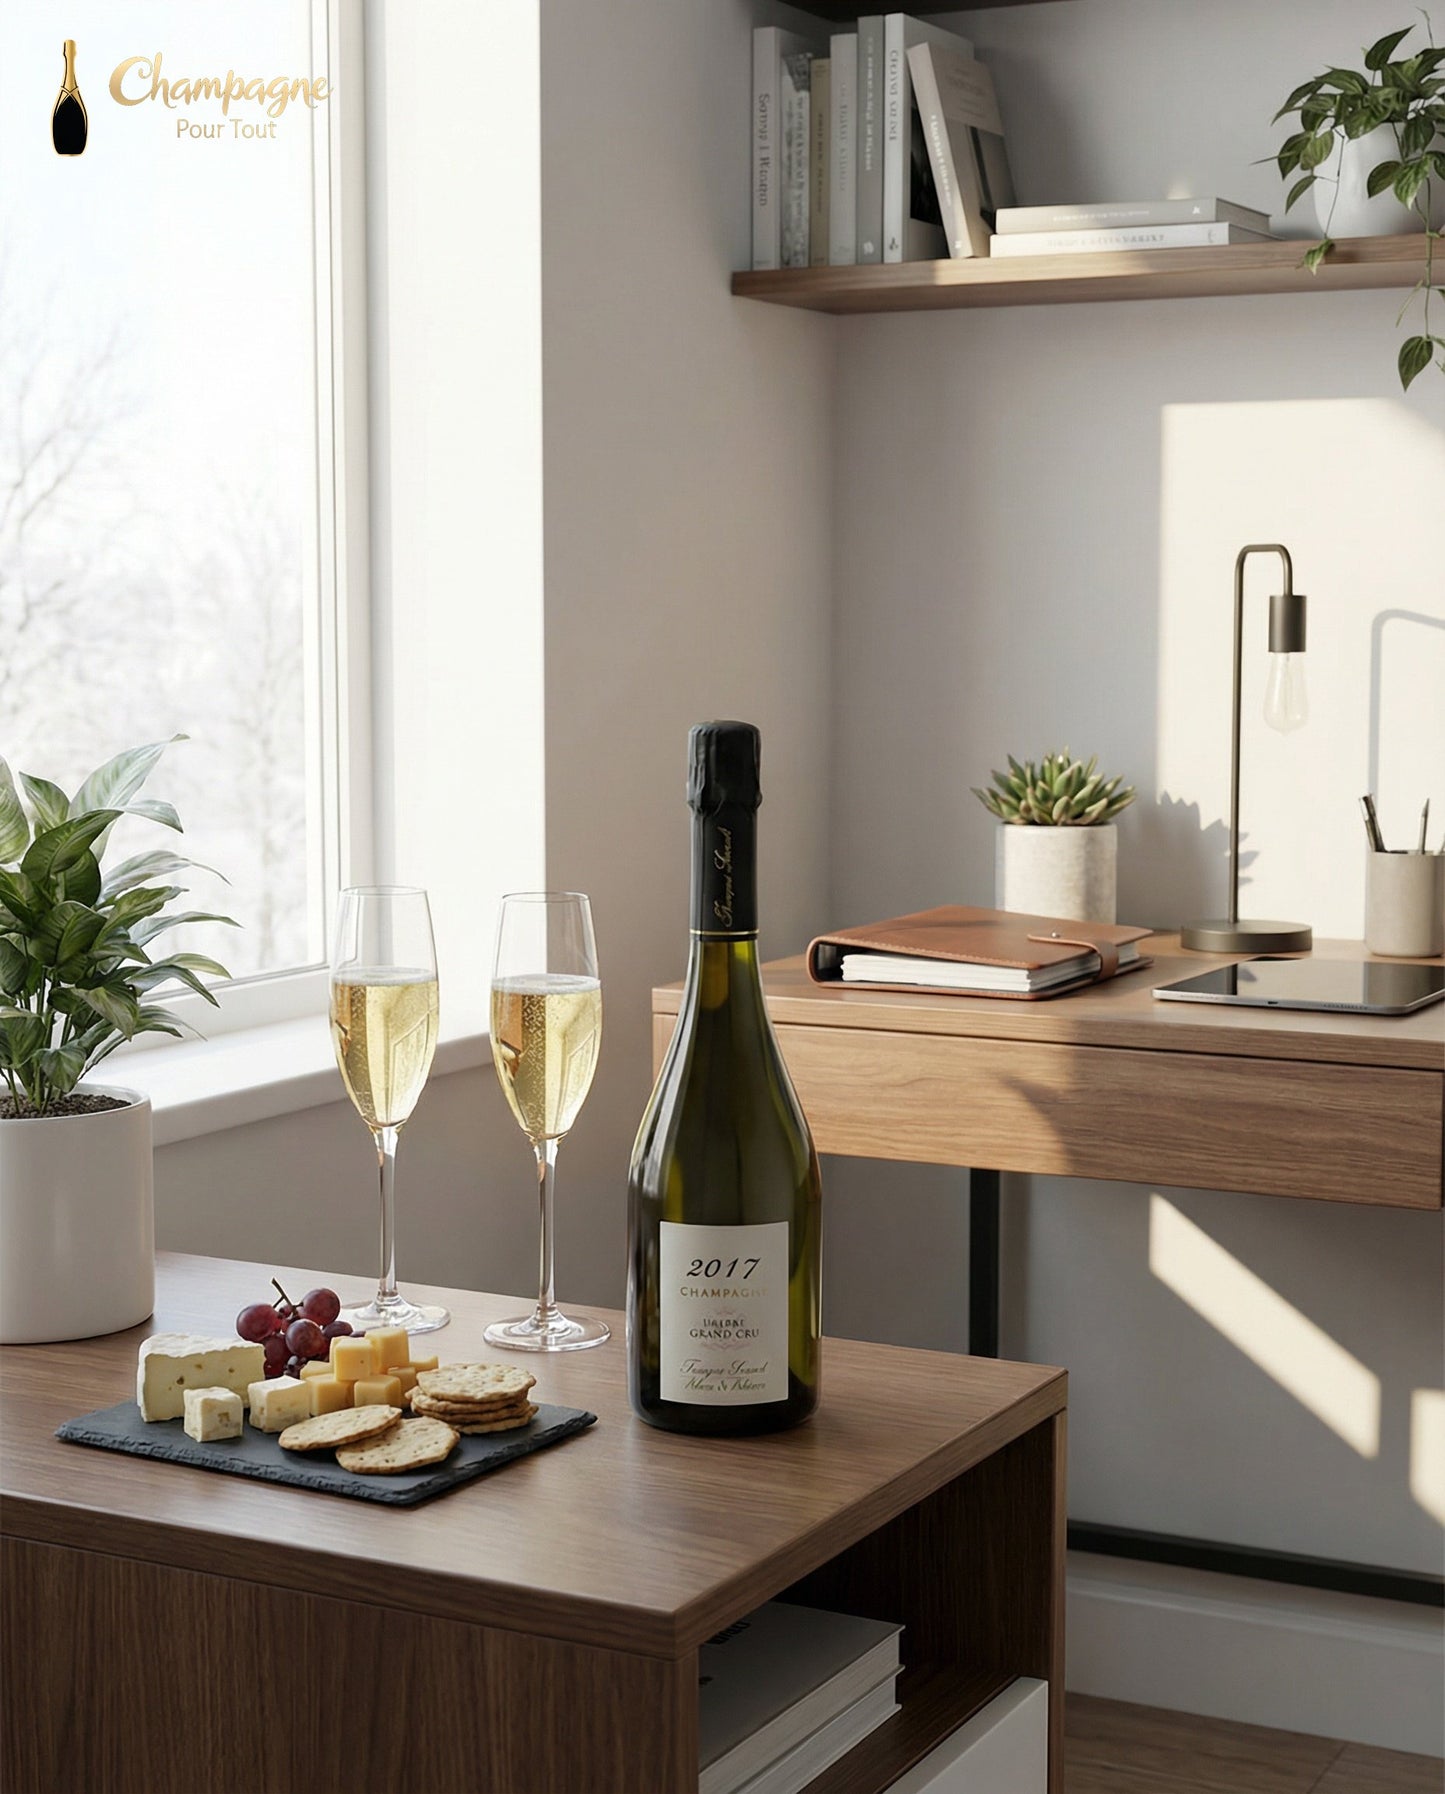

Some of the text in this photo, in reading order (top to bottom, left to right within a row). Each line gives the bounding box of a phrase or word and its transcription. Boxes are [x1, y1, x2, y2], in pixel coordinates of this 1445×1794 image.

[686, 1257, 762, 1280] 2017
[689, 1329, 760, 1340] GRAND CRU
